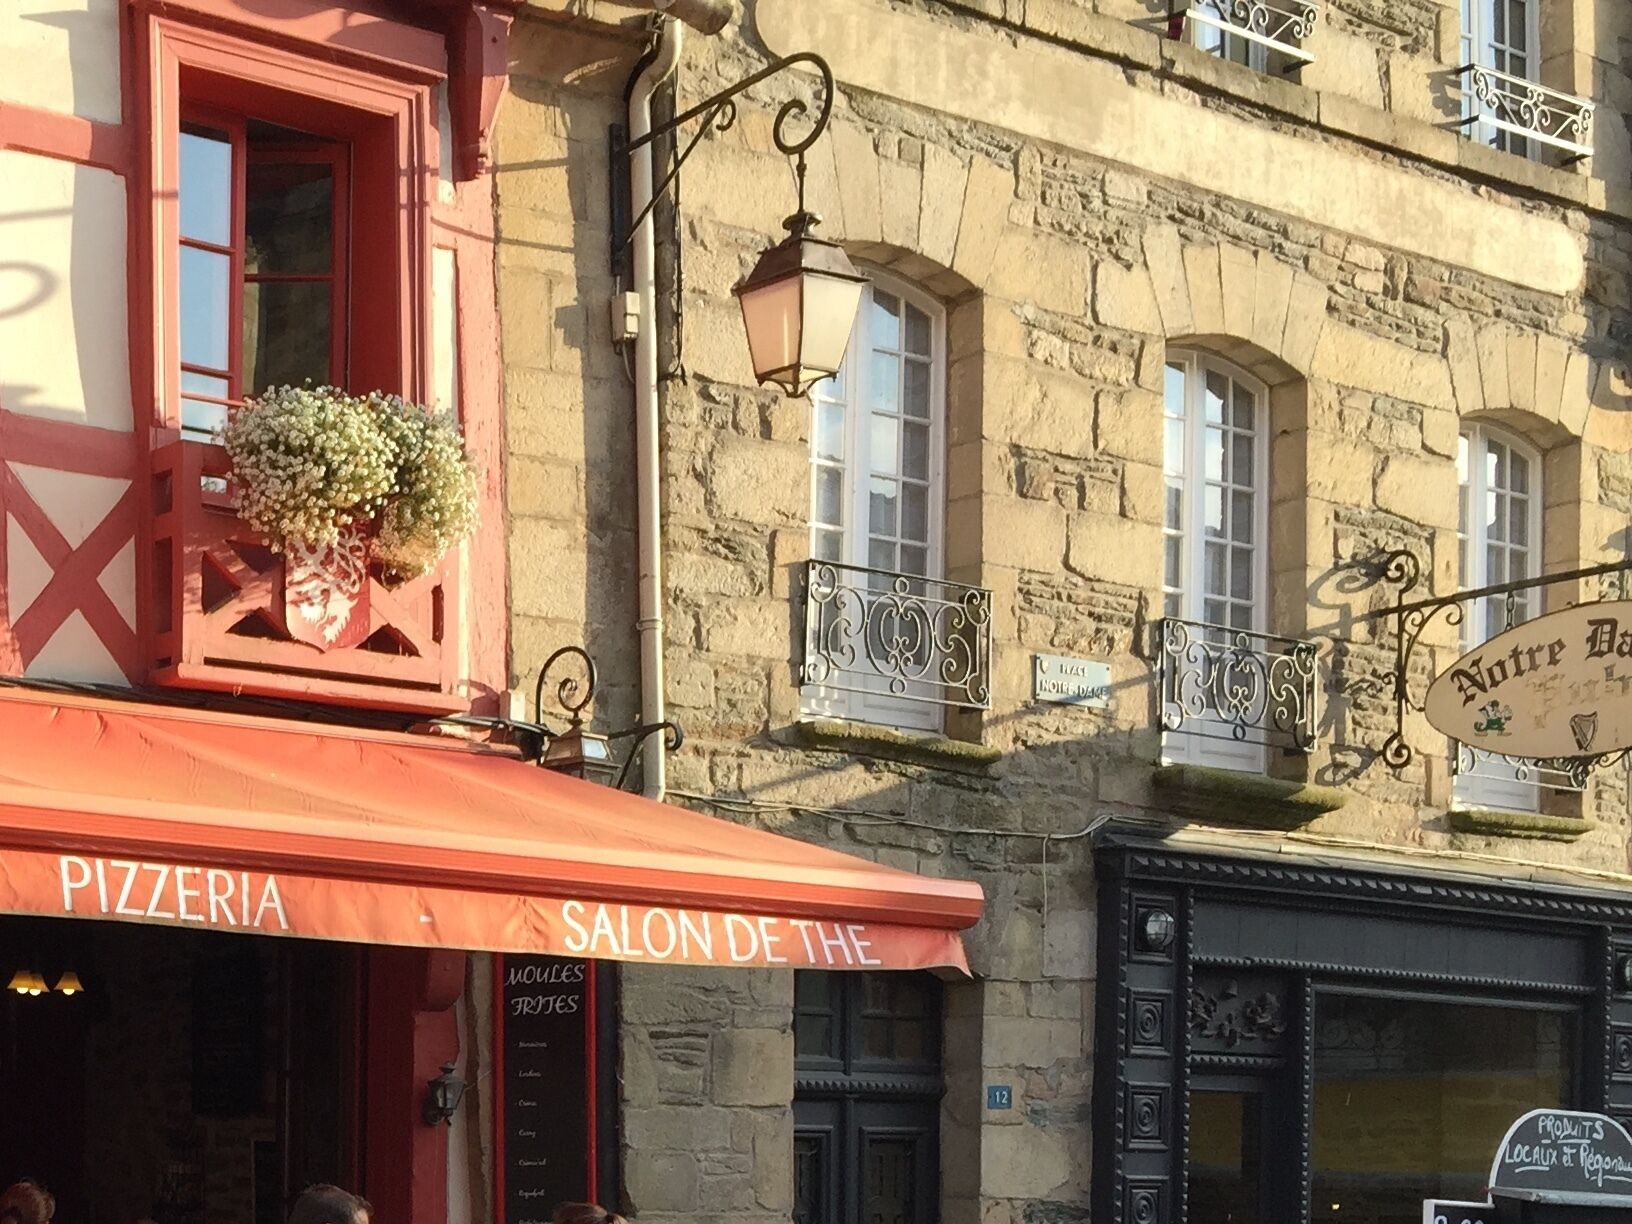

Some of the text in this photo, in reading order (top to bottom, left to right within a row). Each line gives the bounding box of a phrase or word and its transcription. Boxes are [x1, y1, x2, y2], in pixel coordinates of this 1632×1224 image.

[1450, 636, 1567, 708] Notre
[1584, 617, 1632, 660] Da
[59, 854, 290, 931] PIZZERIA
[561, 899, 713, 960] SALON
[723, 913, 788, 963] DE
[789, 918, 882, 966] THE
[504, 964, 586, 987] MOULES
[995, 1090, 1008, 1104] 12
[1579, 1143, 1632, 1188] Régionau
